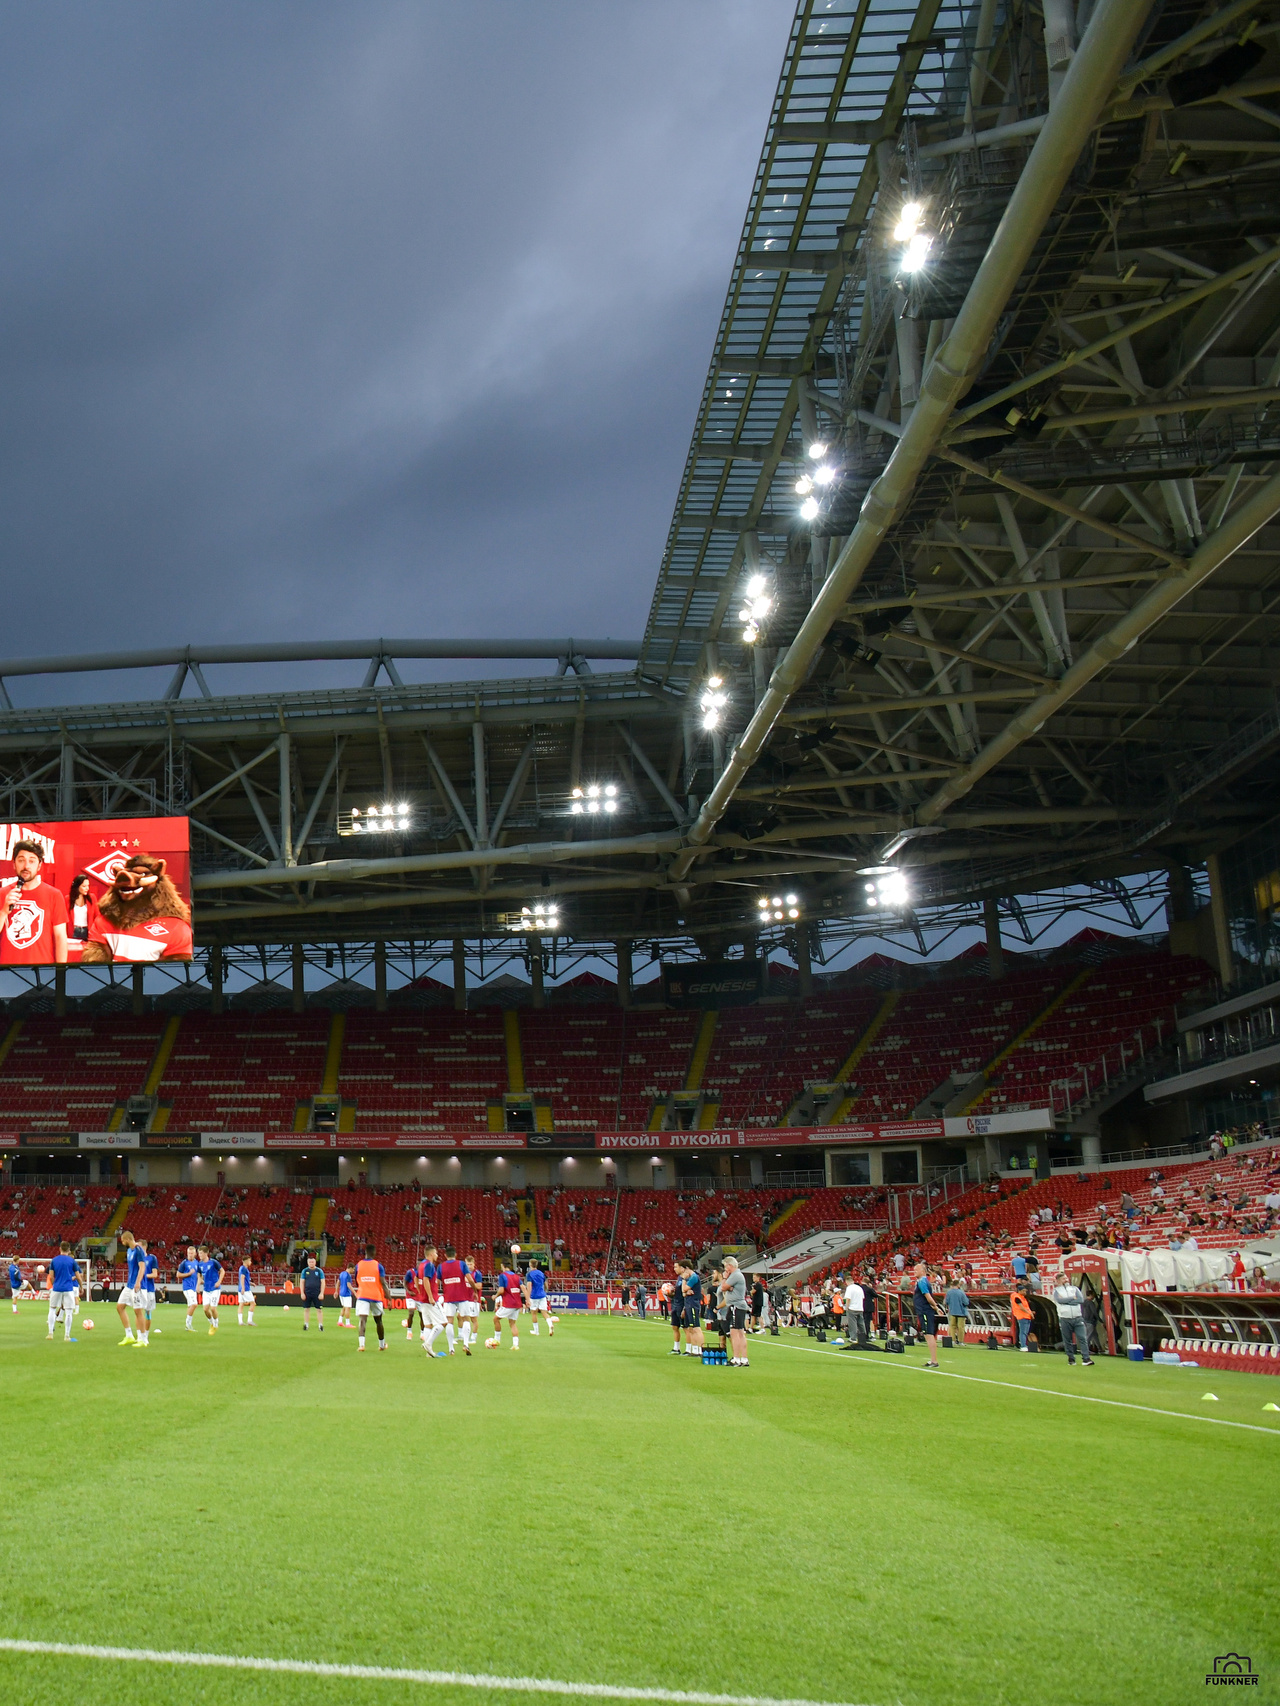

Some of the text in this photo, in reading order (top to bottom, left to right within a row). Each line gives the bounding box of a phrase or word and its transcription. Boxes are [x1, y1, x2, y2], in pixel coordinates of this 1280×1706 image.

[688, 981, 757, 994] GENESIS
[86, 1136, 132, 1145] Яндекс Плюс
[208, 1136, 256, 1145] Яндекс Плюс
[600, 1133, 660, 1146] ЛУКОЙЛ
[669, 1132, 731, 1145] ЛУКОЙЛ
